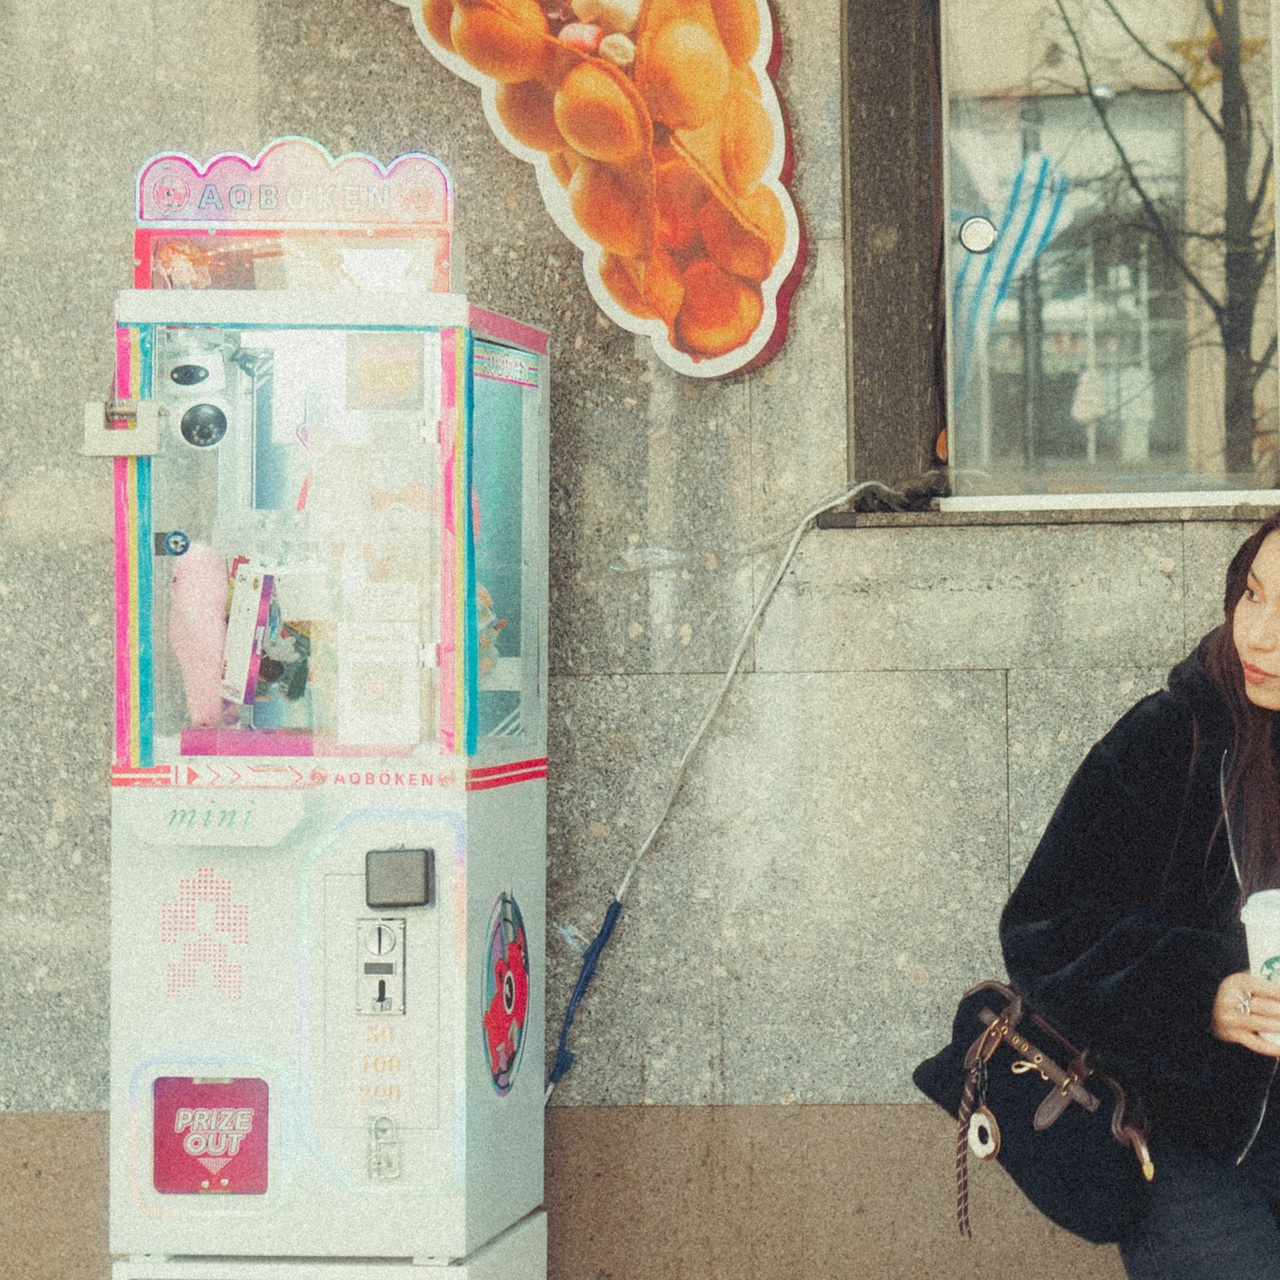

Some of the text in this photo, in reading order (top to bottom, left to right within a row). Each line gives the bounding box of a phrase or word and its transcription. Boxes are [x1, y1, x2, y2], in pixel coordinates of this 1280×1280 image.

[168, 799, 255, 828] mini
[361, 1054, 402, 1075] 100
[174, 1108, 254, 1132] PRIZE
[183, 1132, 245, 1156] OUT
